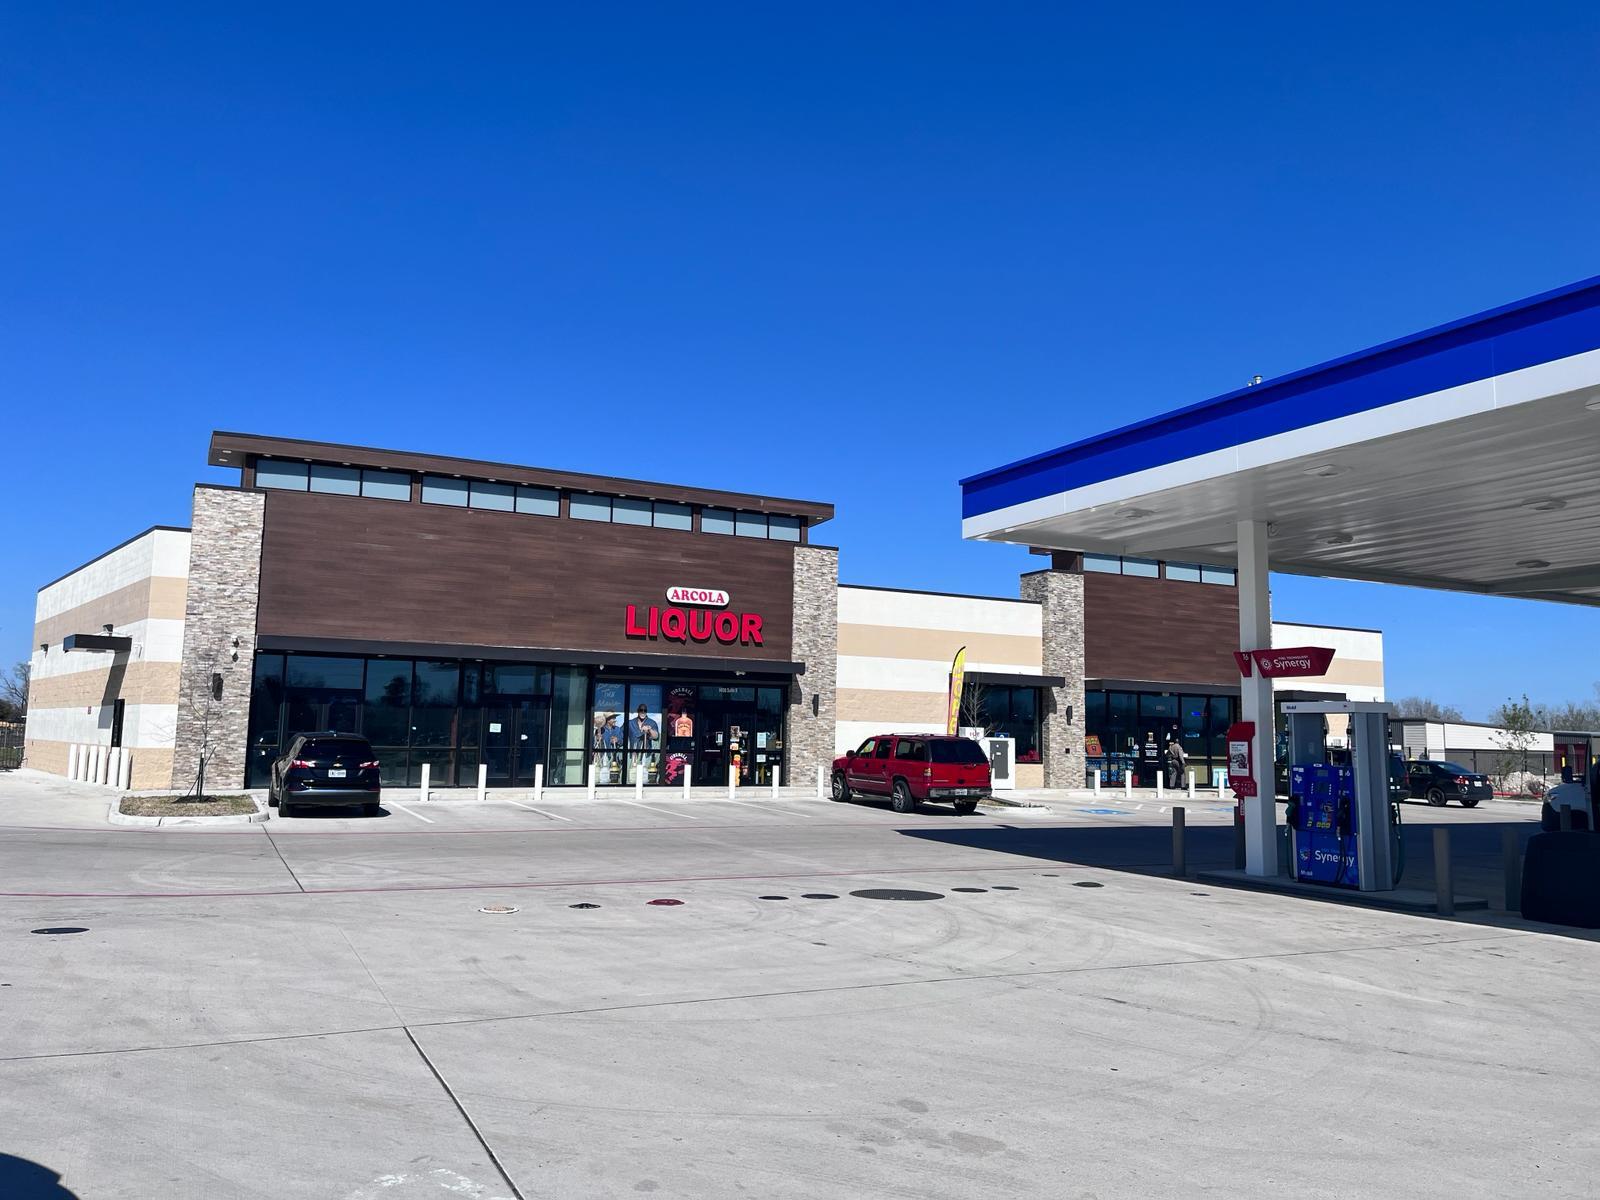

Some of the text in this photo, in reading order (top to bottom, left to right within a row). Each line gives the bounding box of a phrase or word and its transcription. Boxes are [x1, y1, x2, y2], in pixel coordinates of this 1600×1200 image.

[671, 589, 725, 603] ARCOLA
[626, 604, 765, 643] LIQUOR
[1273, 659, 1311, 670] Synergy
